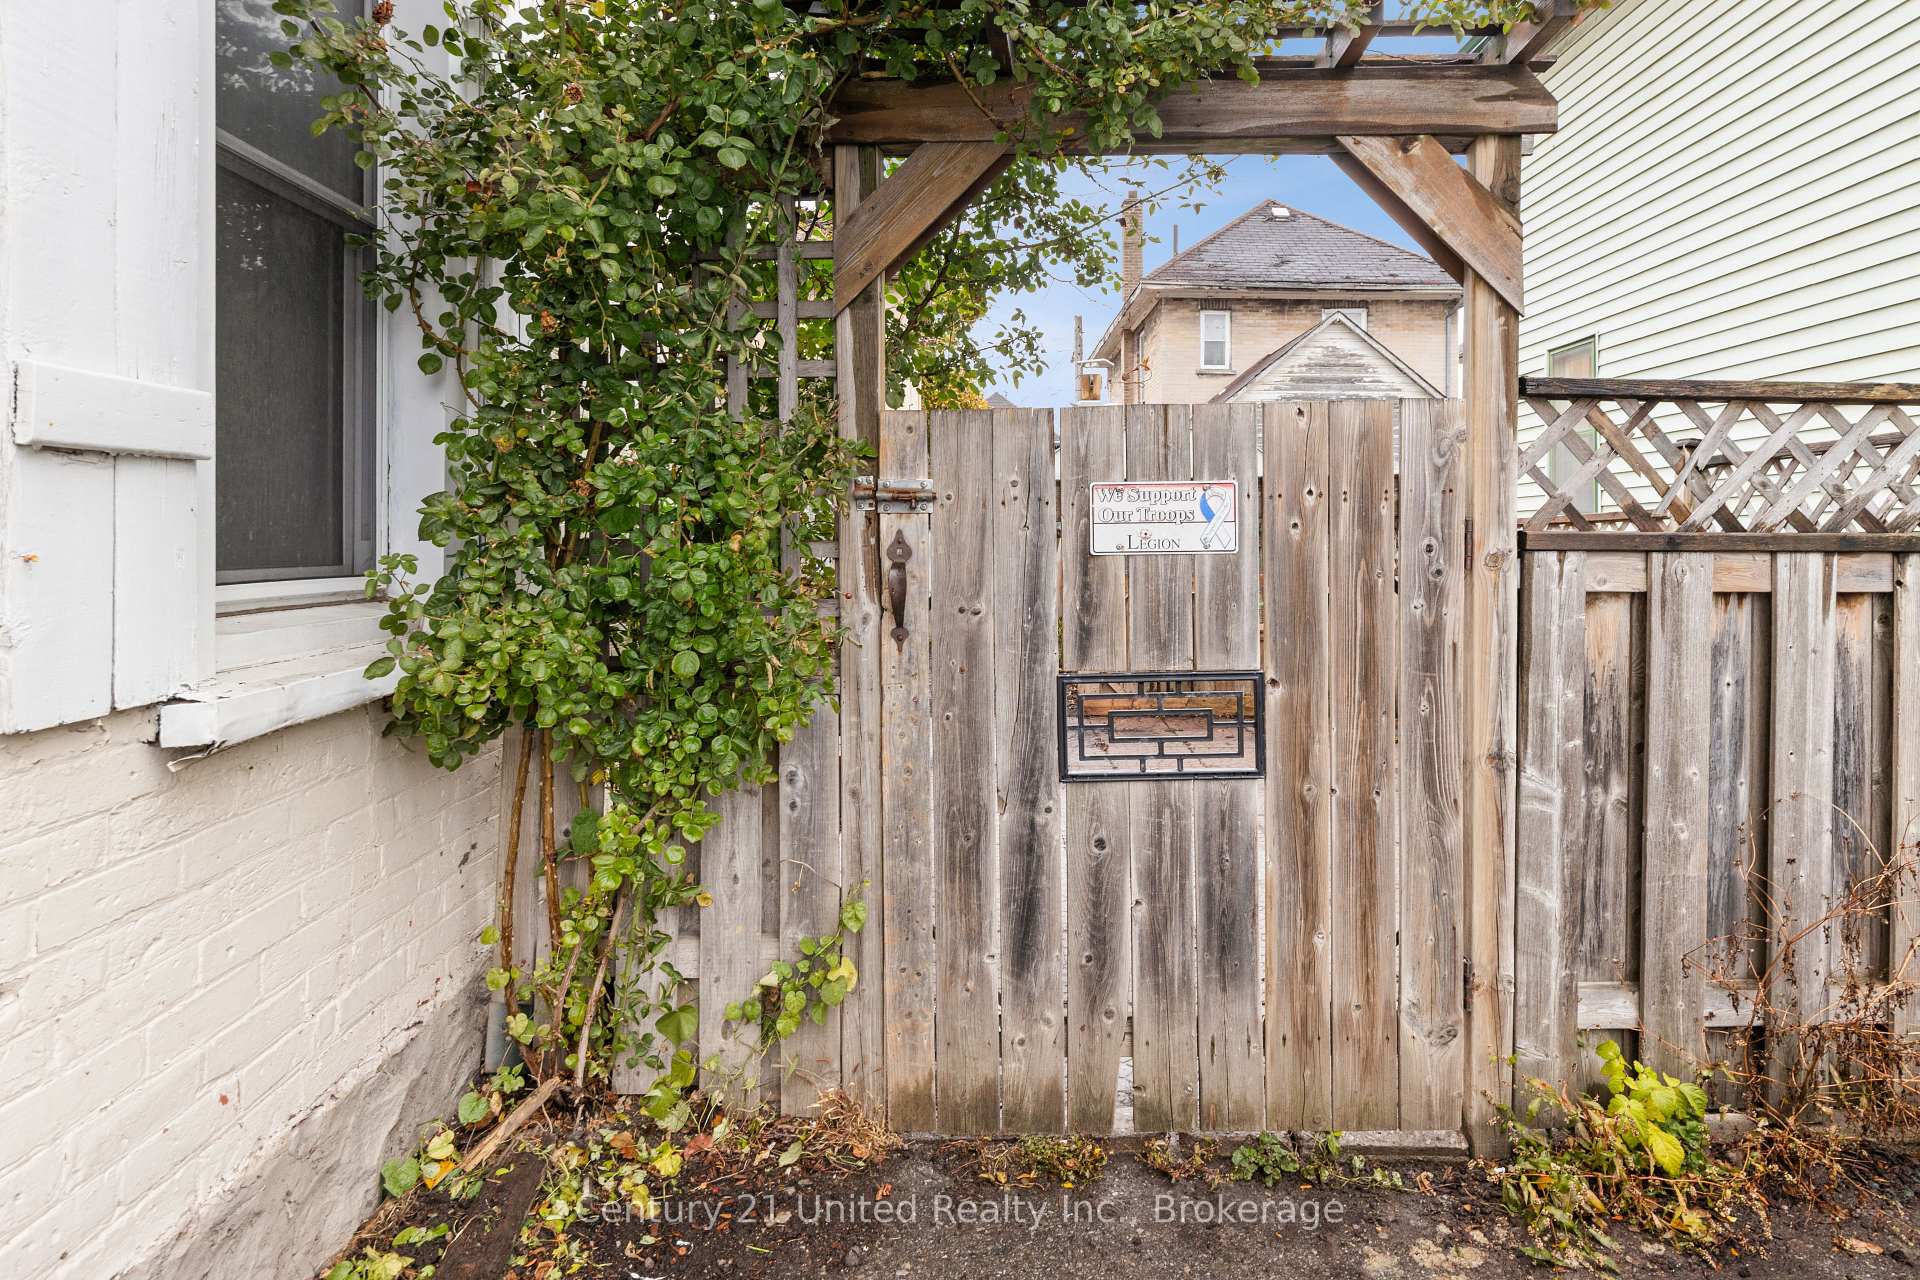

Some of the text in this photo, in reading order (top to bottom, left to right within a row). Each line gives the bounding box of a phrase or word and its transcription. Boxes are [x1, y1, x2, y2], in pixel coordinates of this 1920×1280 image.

[1127, 486, 1197, 506] Support
[1098, 507, 1195, 525] Our Troops
